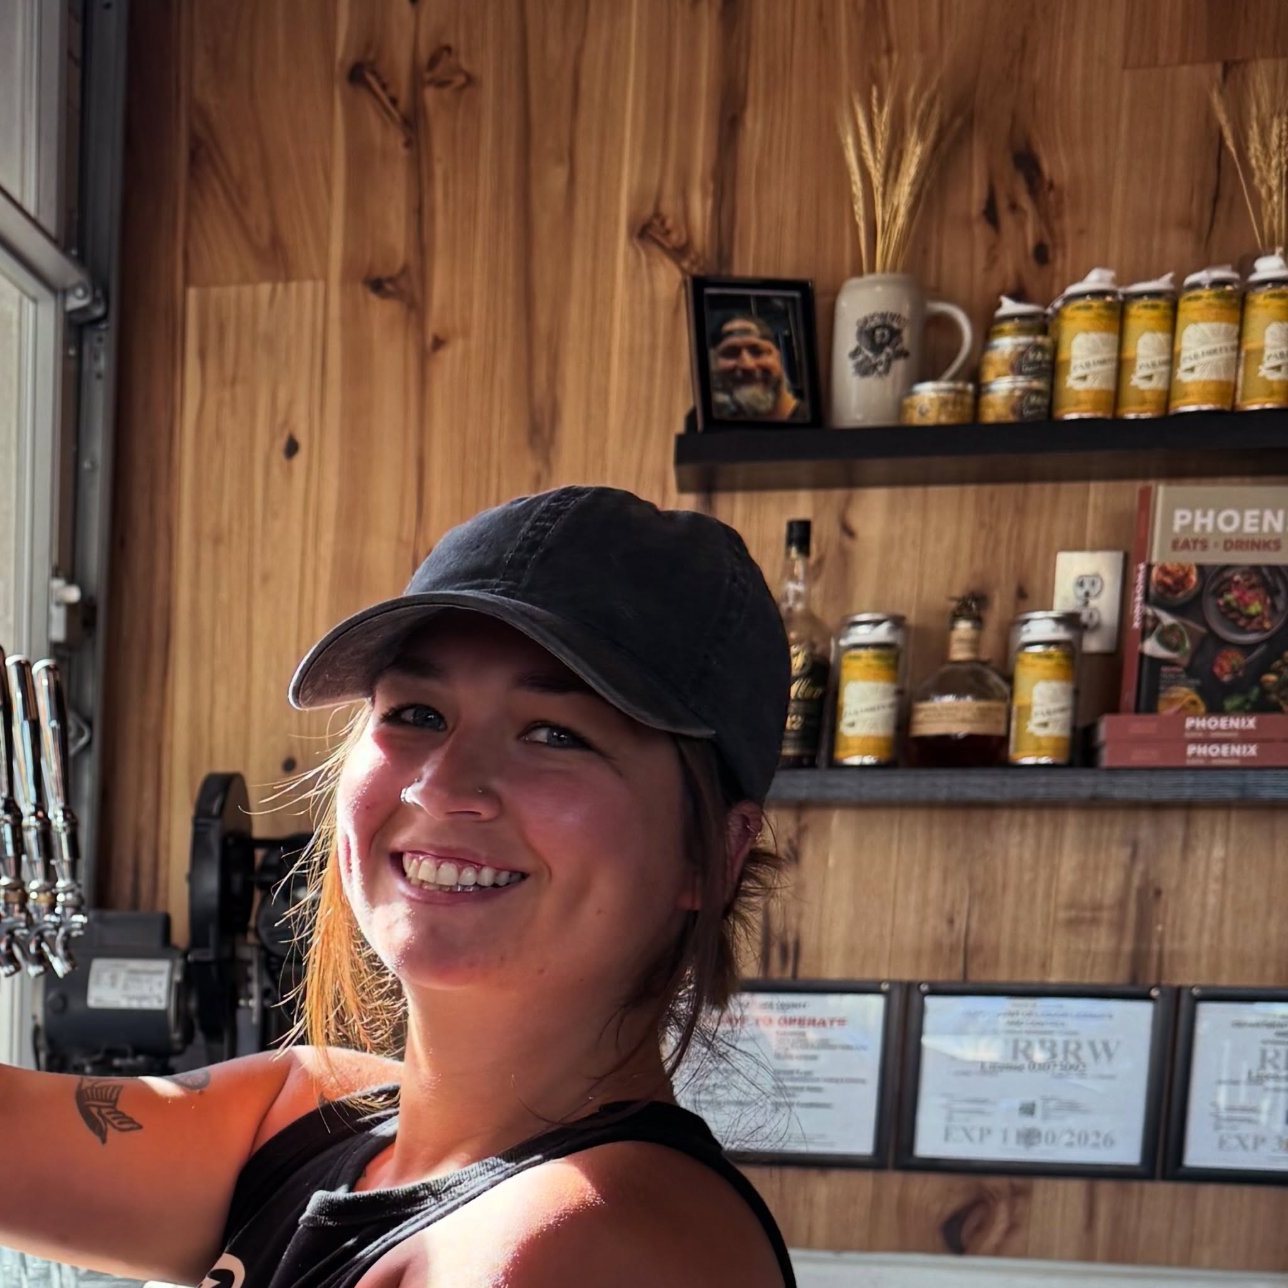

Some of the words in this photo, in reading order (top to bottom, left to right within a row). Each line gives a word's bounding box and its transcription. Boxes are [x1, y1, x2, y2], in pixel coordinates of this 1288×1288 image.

[1172, 508, 1288, 535] PHOEN
[1170, 537, 1208, 552] EATS
[1222, 537, 1282, 552] DRINKS
[1184, 716, 1257, 731] PHOENIX
[1186, 743, 1258, 758] PHOENIX
[777, 1015, 848, 1028] OPERATE
[943, 1125, 992, 1144] EXP
